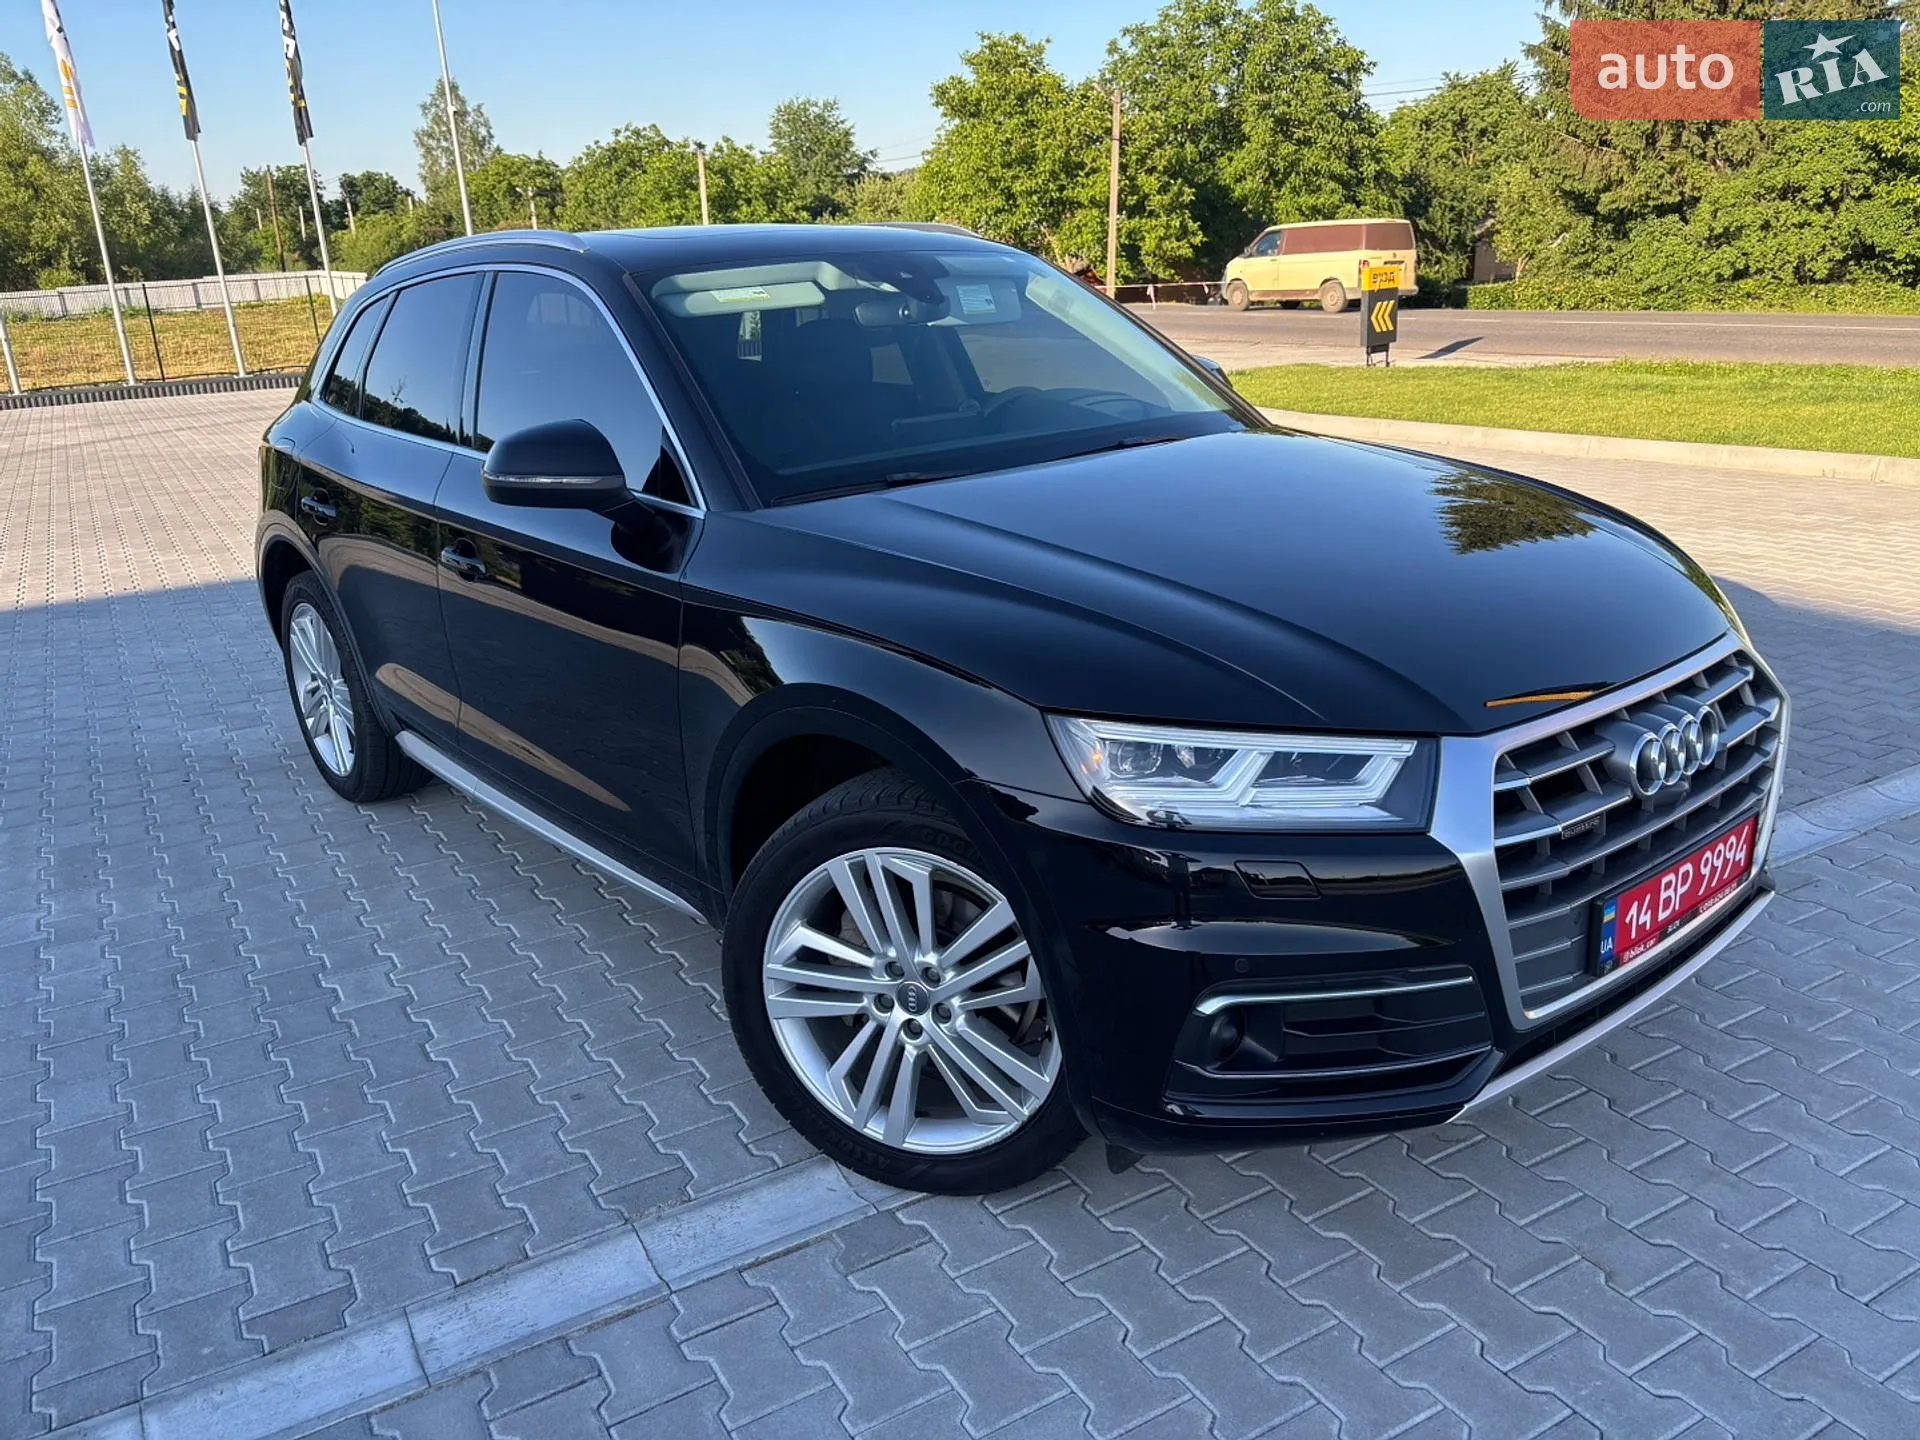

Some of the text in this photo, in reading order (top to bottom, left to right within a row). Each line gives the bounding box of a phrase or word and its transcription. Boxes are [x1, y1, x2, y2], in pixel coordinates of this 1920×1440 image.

[1625, 893, 1652, 940] 14
[1657, 862, 1694, 922] BP
[1698, 825, 1749, 896] 9994
[1600, 936, 1614, 954] UA
